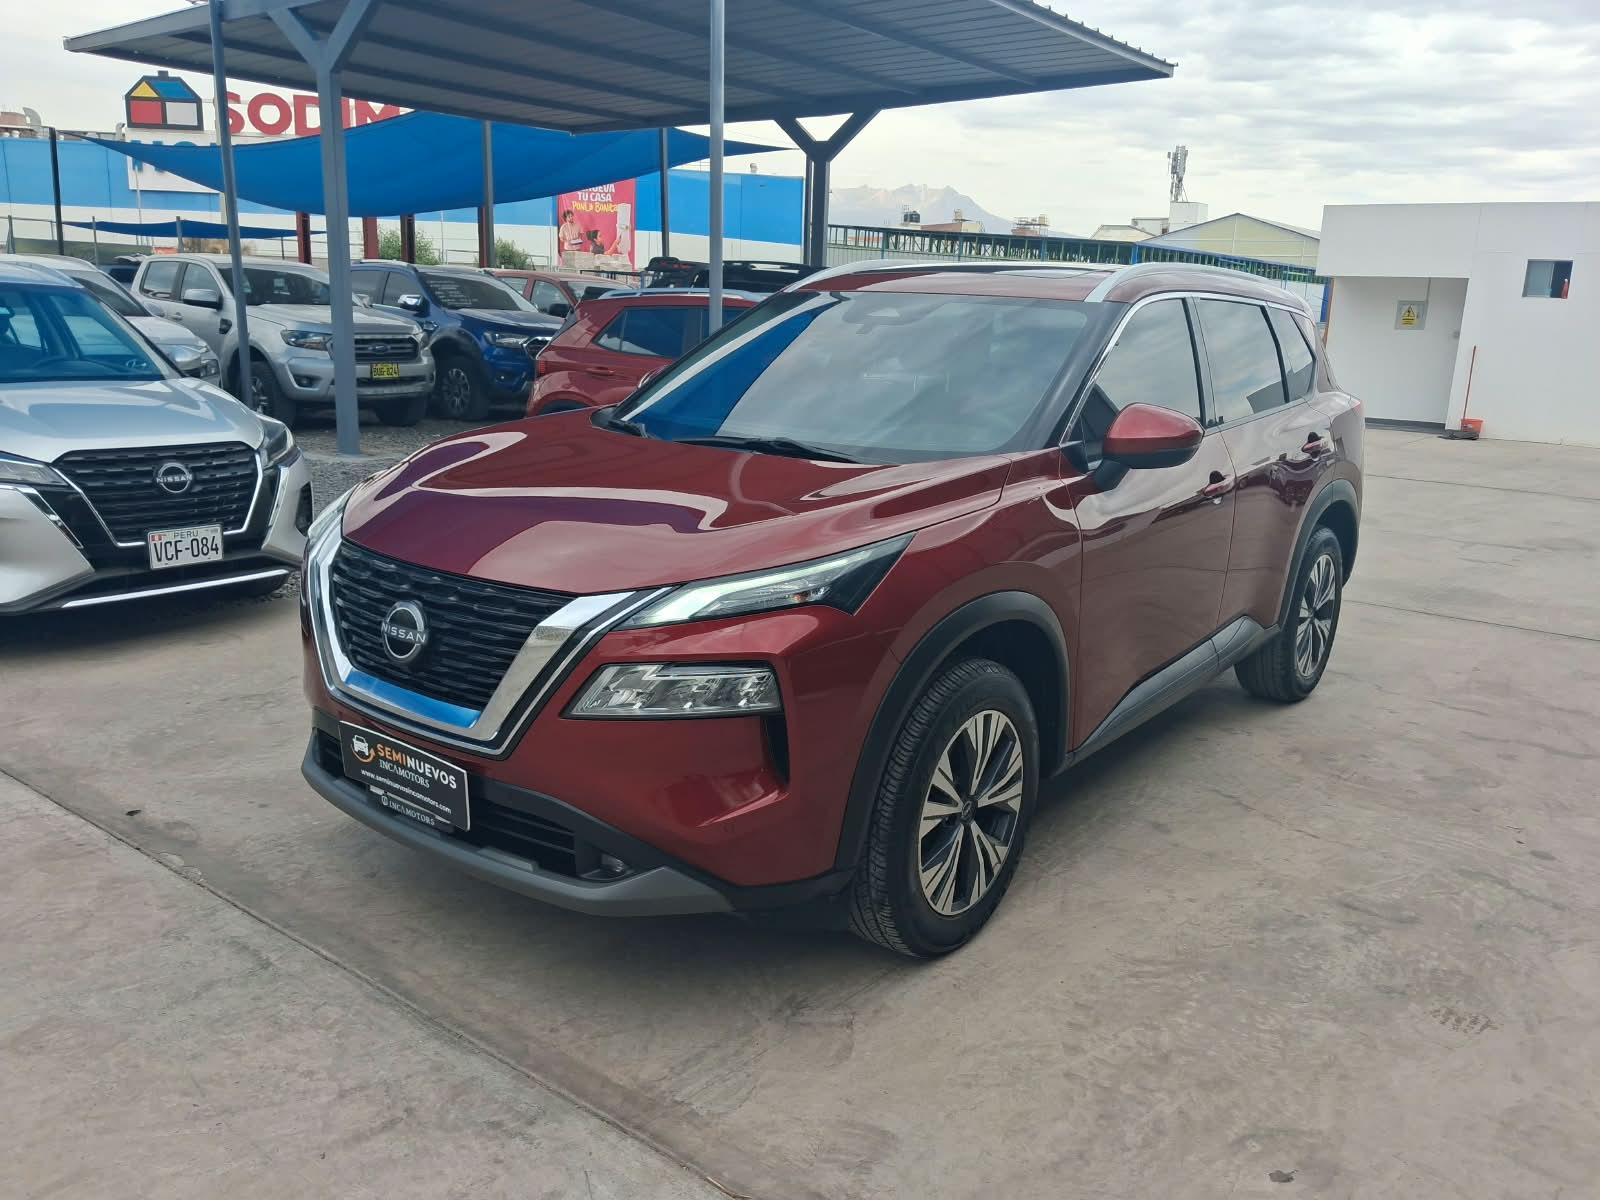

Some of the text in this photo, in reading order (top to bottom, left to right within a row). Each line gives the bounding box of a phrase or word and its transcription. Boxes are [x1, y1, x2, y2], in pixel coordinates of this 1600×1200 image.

[577, 191, 613, 202] TU CASA
[156, 473, 193, 483] NISSAN
[173, 530, 199, 539] PERU
[153, 535, 219, 562] VCF-084
[381, 621, 426, 643] NISSAN
[376, 743, 457, 789] SEMINUEVOS
[379, 758, 430, 788] INCAMOTORS
[389, 800, 435, 826] INCAMOTORS
